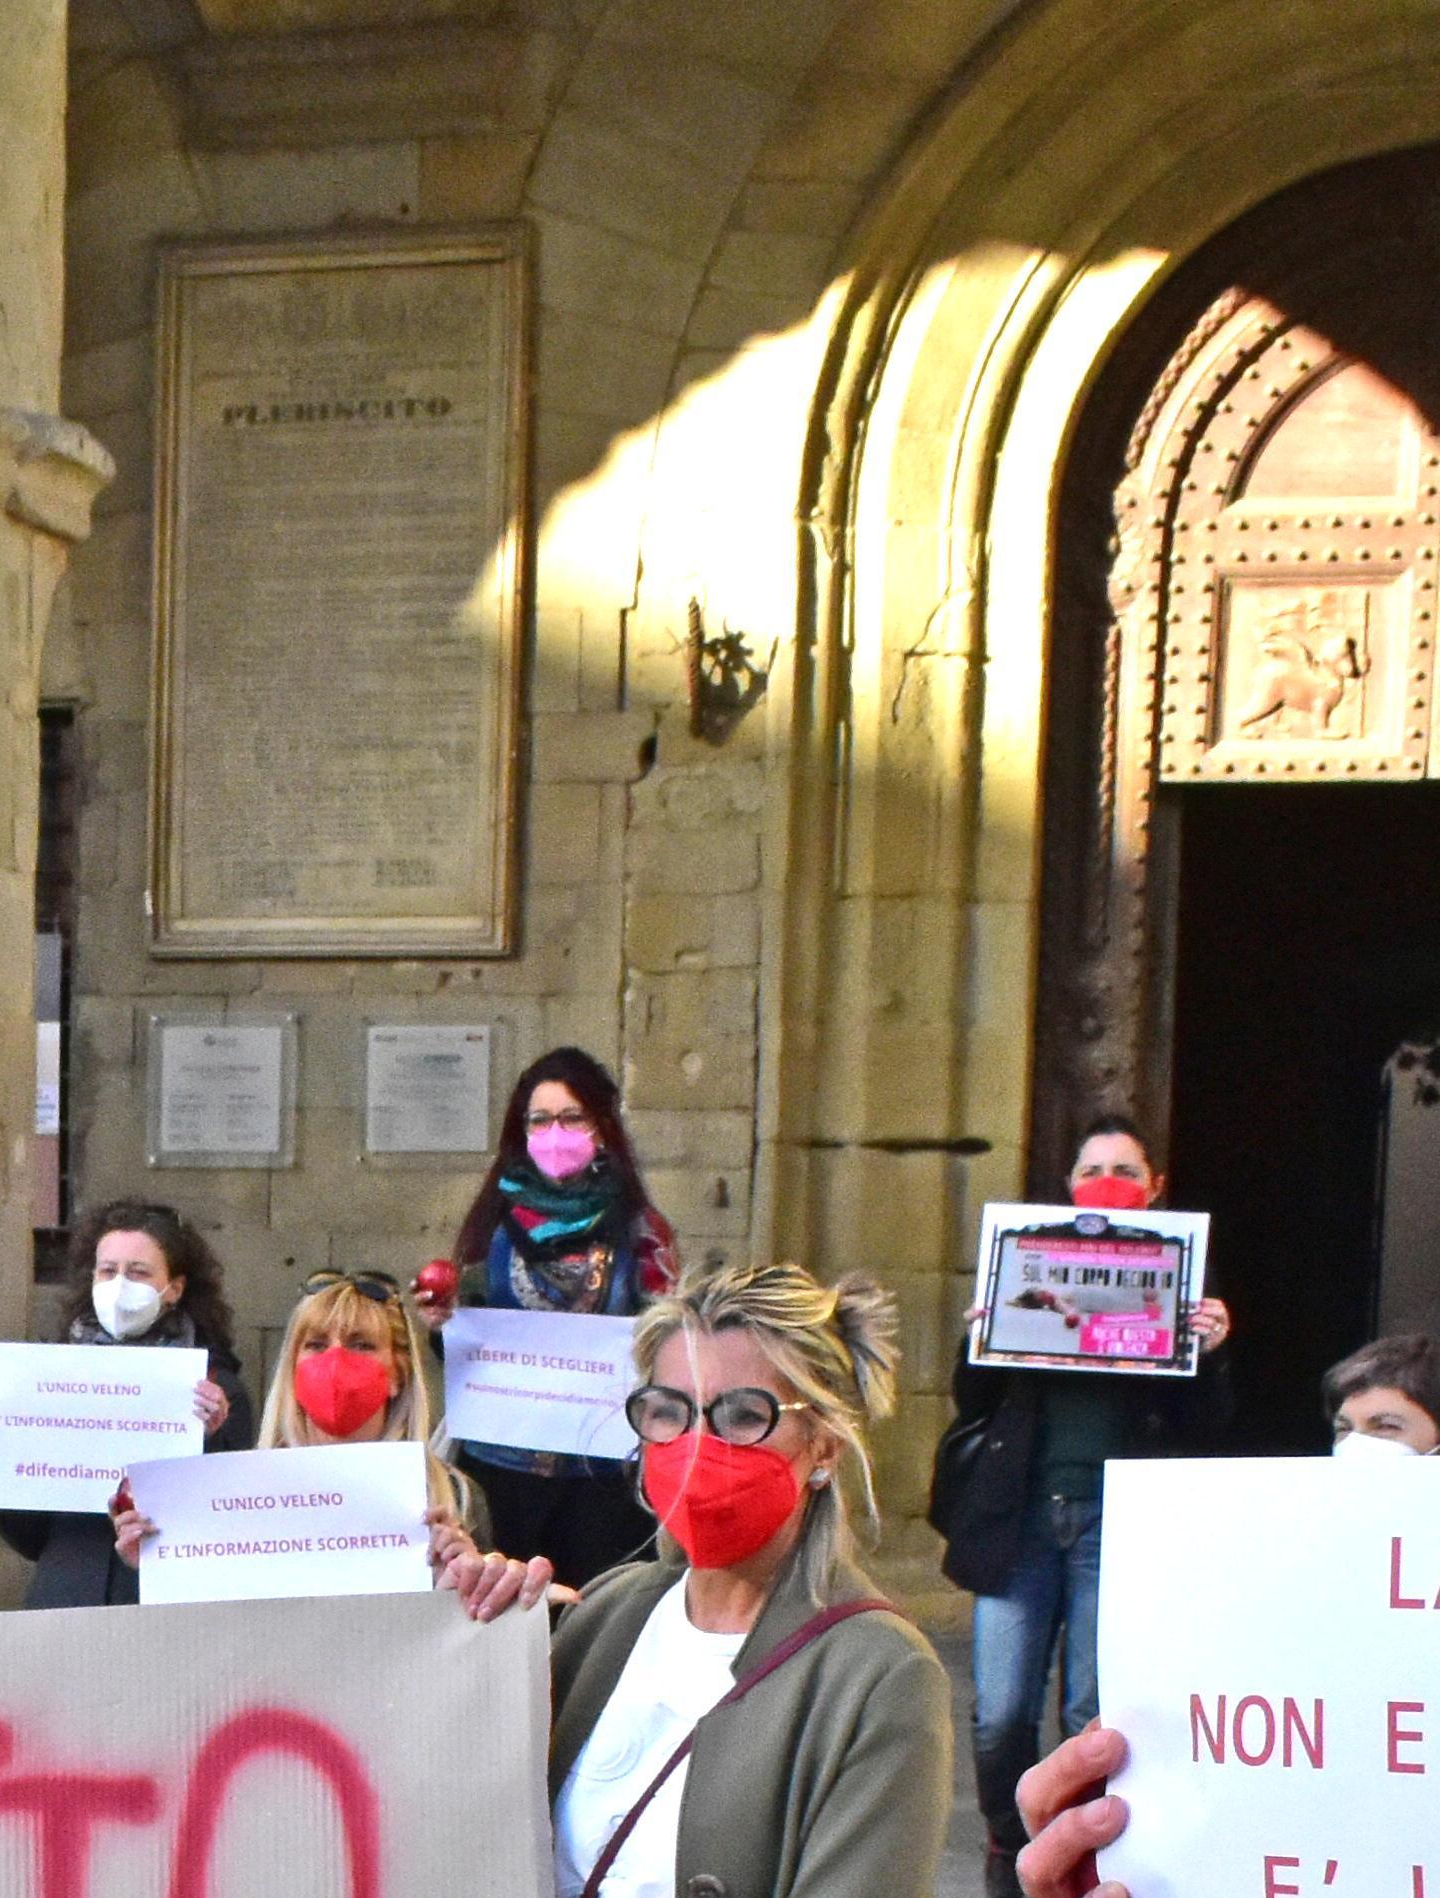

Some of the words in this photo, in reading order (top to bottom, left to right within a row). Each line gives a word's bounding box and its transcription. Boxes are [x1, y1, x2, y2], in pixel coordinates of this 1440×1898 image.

[468, 1349, 517, 1364] LIBERE
[521, 1353, 536, 1366] DI
[541, 1356, 615, 1376] SCEGLIERE
[37, 1382, 88, 1394] L'UNICO
[91, 1383, 141, 1396] VELENO
[5, 1416, 113, 1430] L'INFORMAZIONE
[117, 1420, 188, 1434] SCORRETTA
[15, 1463, 126, 1481] #difendiamol
[212, 1495, 276, 1512] L'UNICO
[280, 1492, 343, 1509] VELENO
[174, 1538, 313, 1559] L'INFORMAZIONE
[318, 1533, 410, 1551] SCORRETTA
[1190, 1693, 1325, 1770] NON
